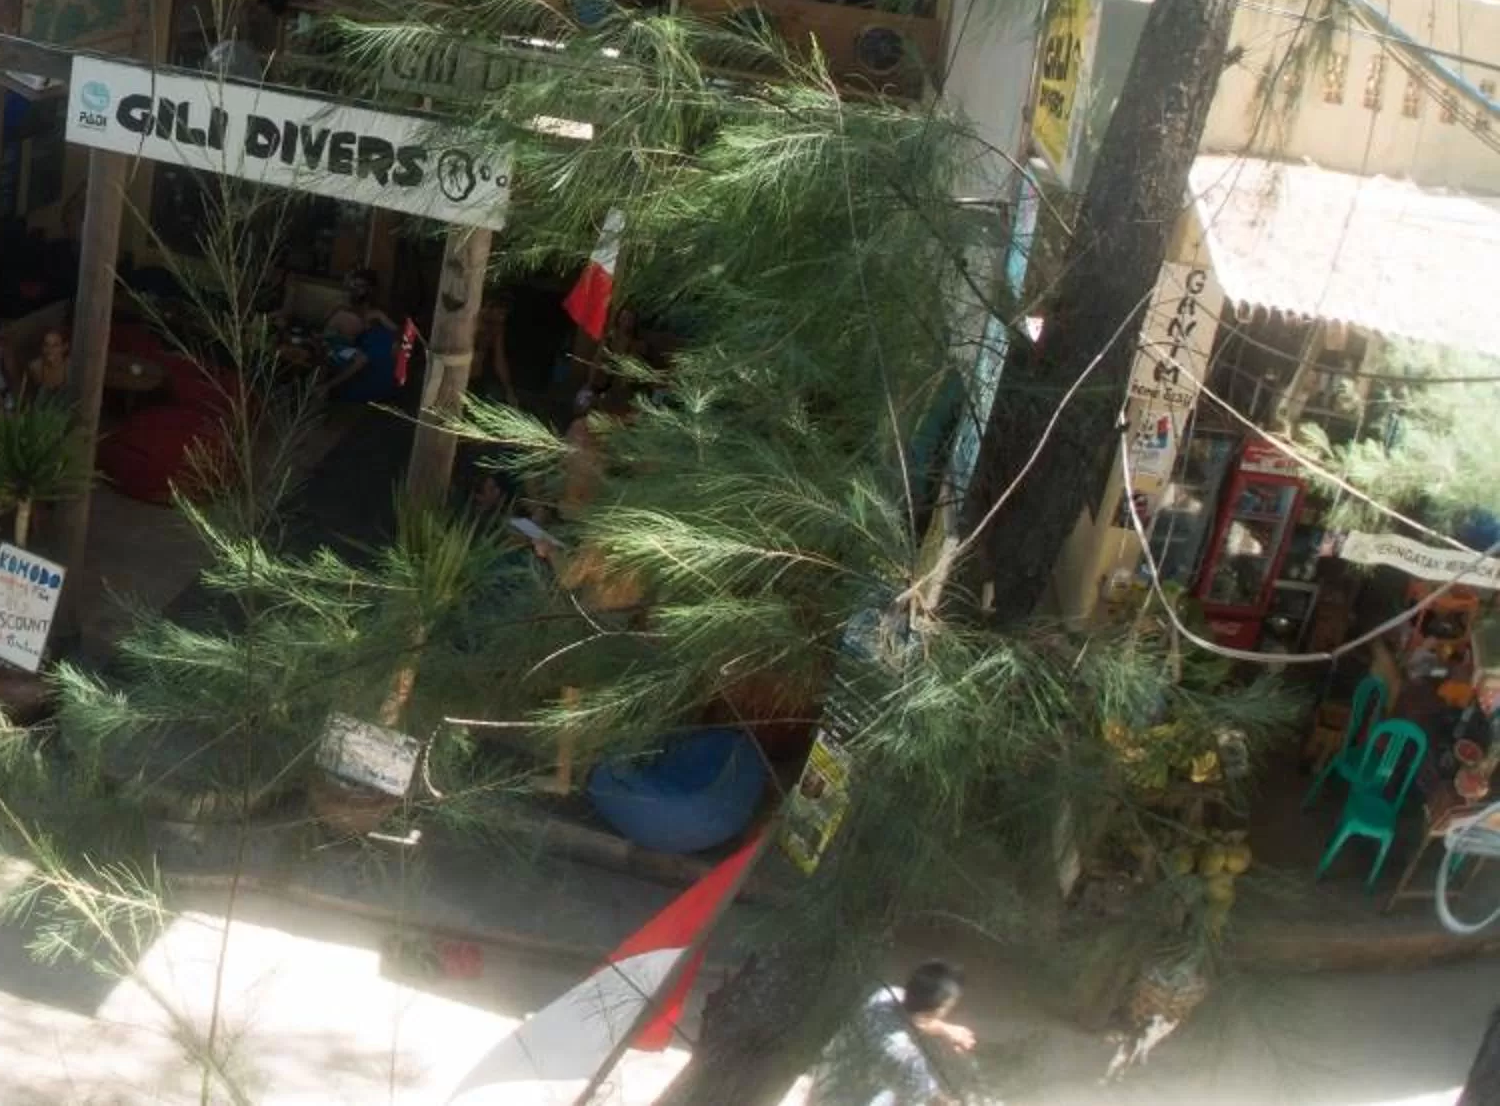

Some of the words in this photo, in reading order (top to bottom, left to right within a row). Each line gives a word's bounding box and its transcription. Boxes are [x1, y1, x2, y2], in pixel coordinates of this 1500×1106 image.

[79, 111, 107, 127] PADI
[115, 93, 229, 151] GILI
[245, 114, 427, 188] DIVERS
